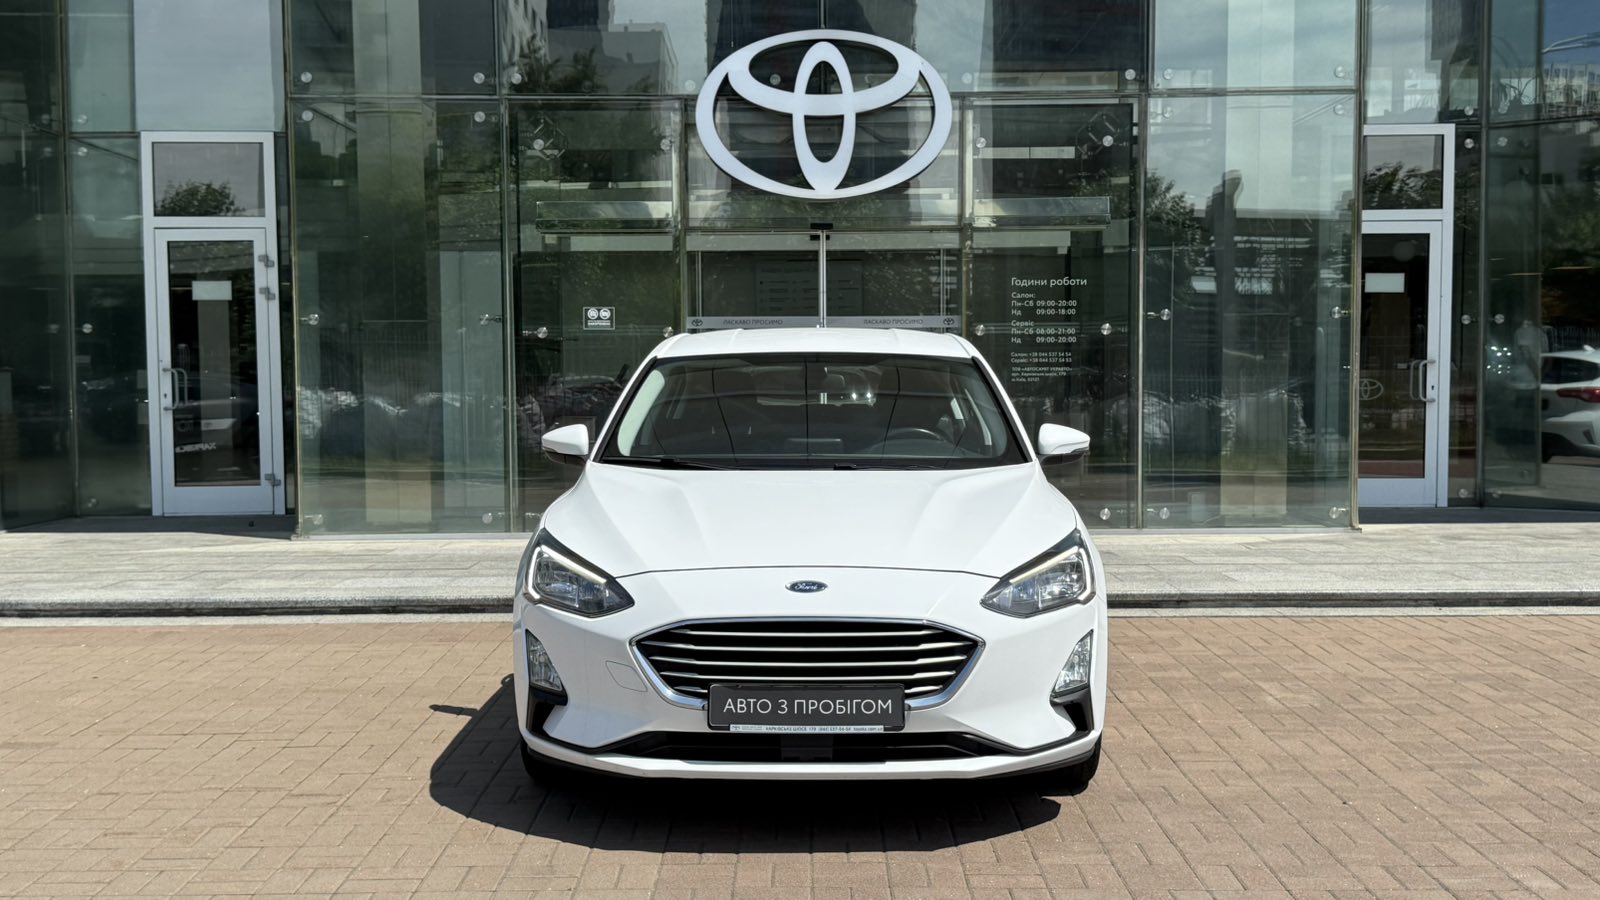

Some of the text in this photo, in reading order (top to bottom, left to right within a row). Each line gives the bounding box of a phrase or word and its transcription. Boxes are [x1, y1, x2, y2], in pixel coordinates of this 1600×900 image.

[1011, 276, 1087, 287] Години роботи
[1011, 308, 1022, 316] Нд
[723, 698, 893, 715] АВТО З ПРОБІГОМ
